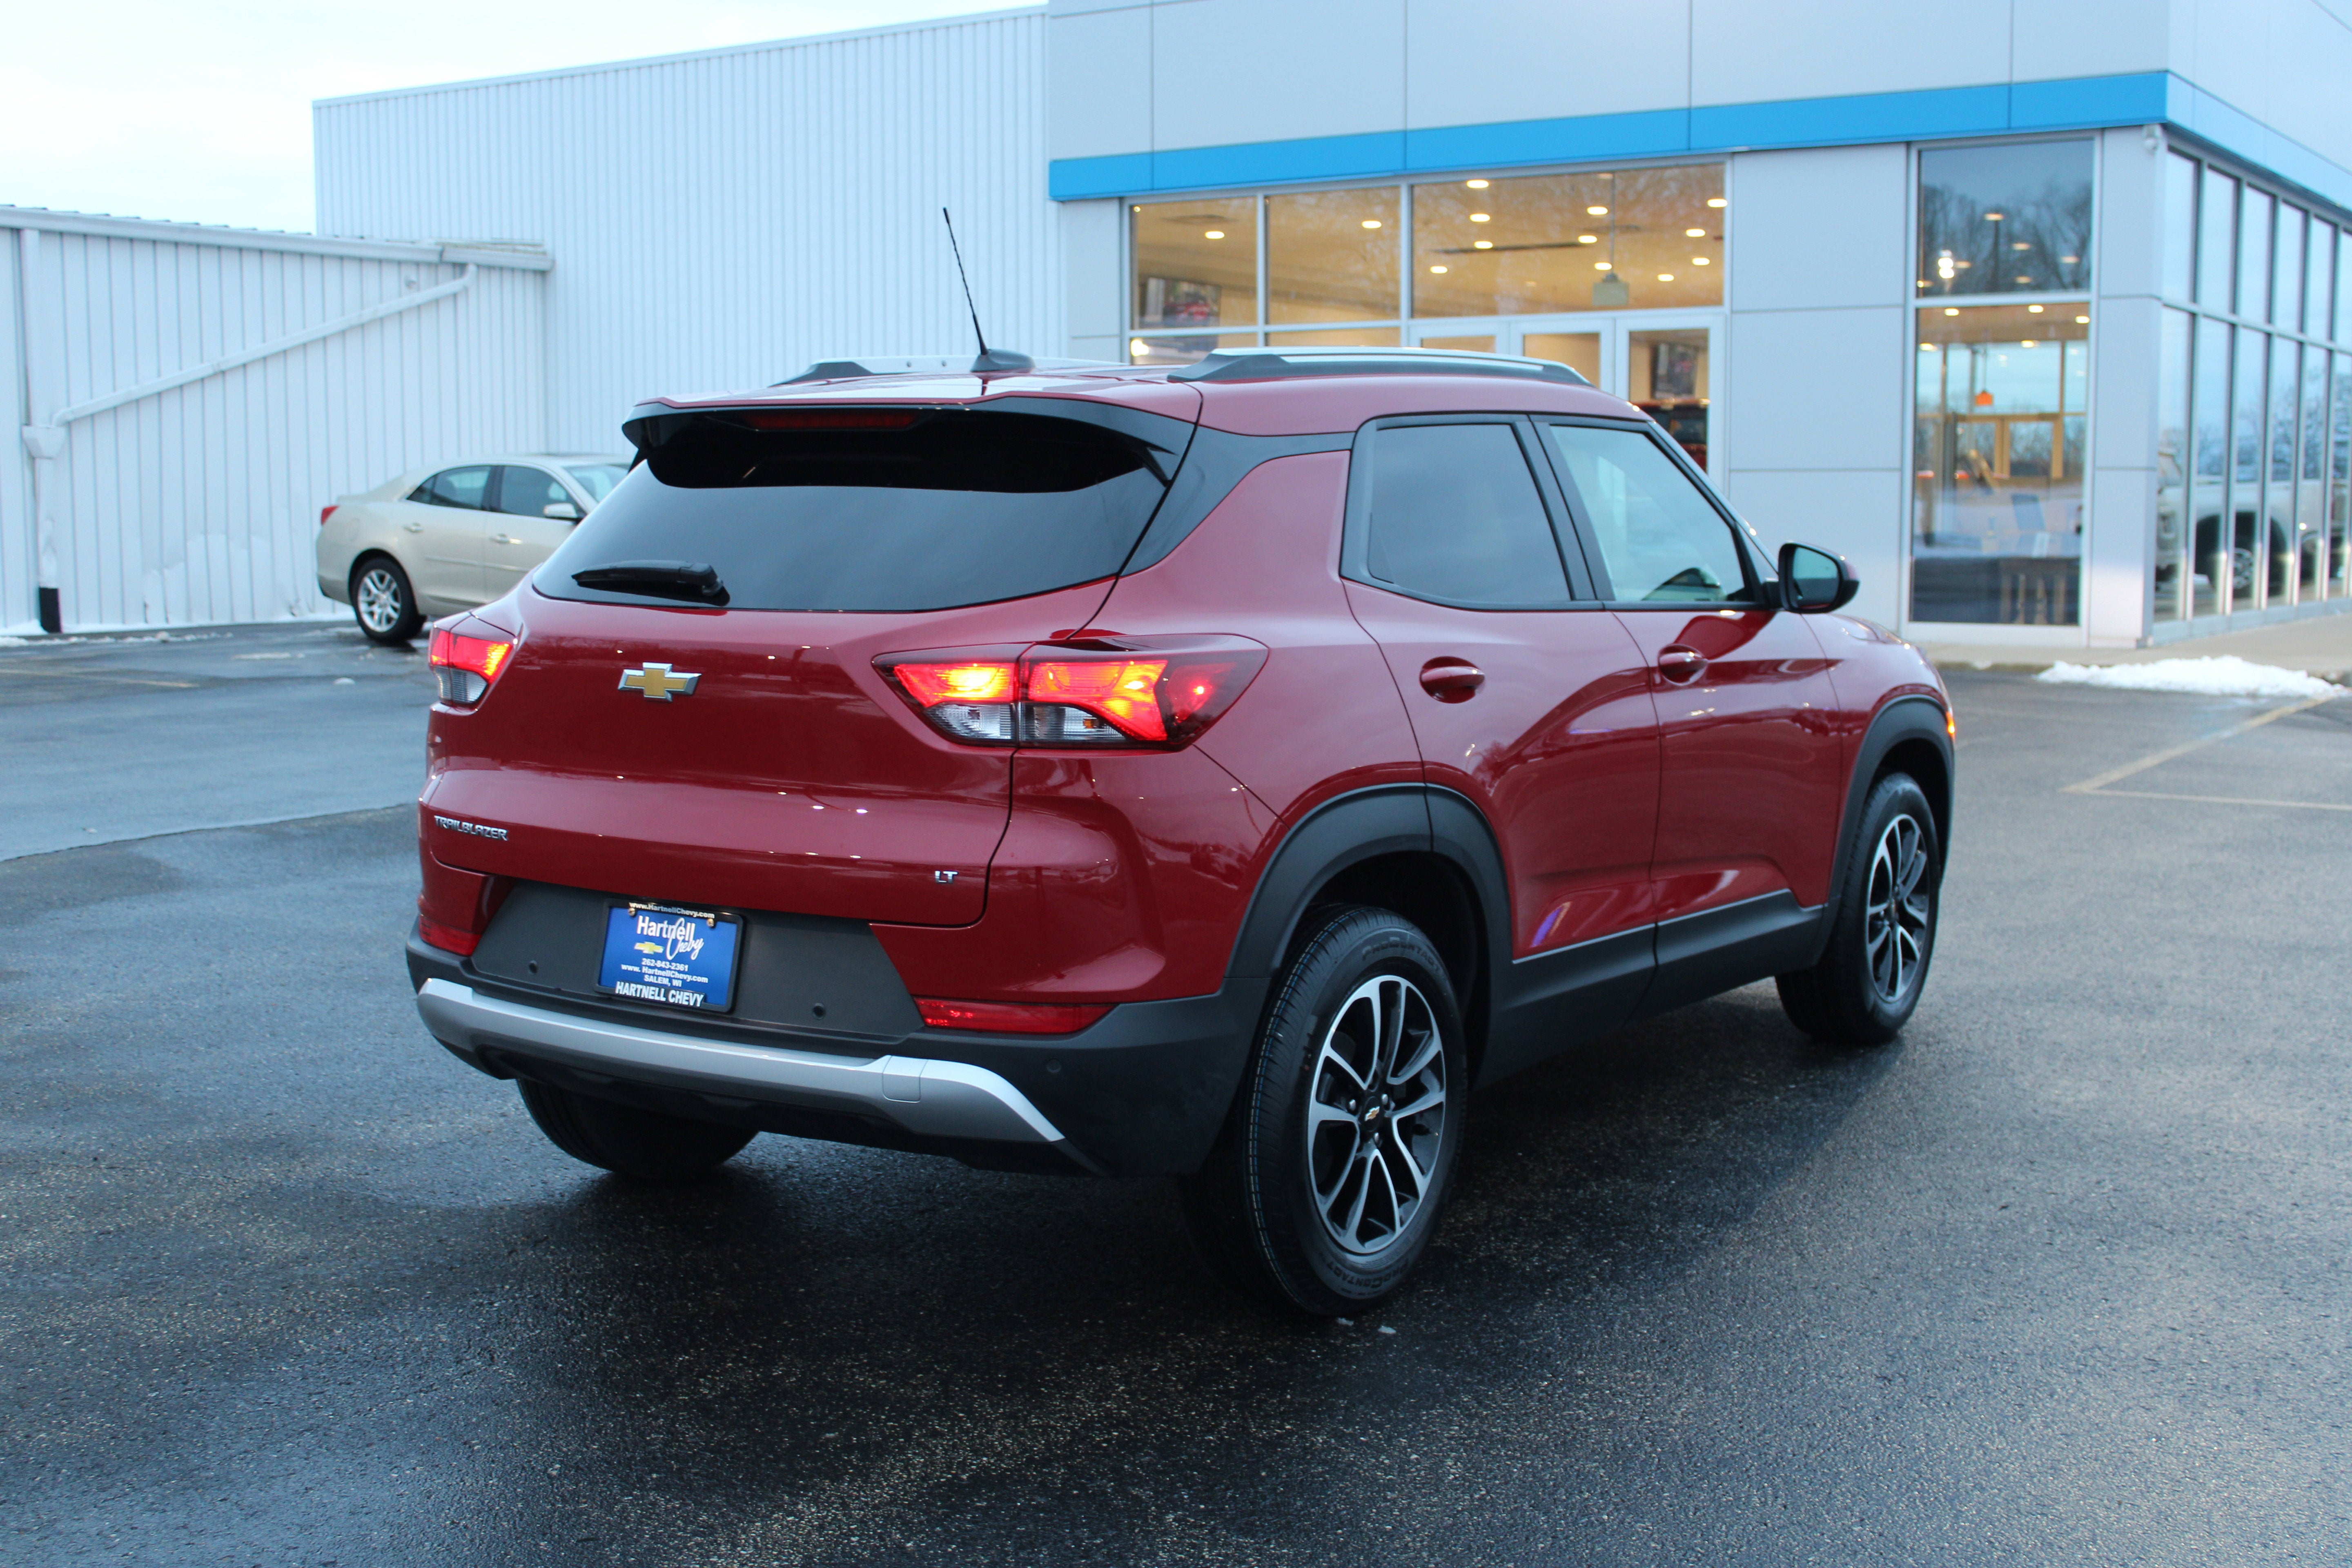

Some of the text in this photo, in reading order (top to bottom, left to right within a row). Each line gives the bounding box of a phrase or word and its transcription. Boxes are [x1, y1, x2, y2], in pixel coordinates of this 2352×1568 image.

[434, 815, 509, 841] TRAILBLAZER
[935, 871, 958, 883] LT
[629, 902, 715, 919] www.HartnellChevy.com
[637, 915, 695, 941] Hartnell
[666, 918, 704, 960] Chevy
[621, 964, 708, 983] www. HartnellChevy.com
[641, 958, 689, 972] 262-843-2361
[644, 975, 671, 987] SALEM,
[615, 981, 705, 1007] HARTNELL CHEVY
